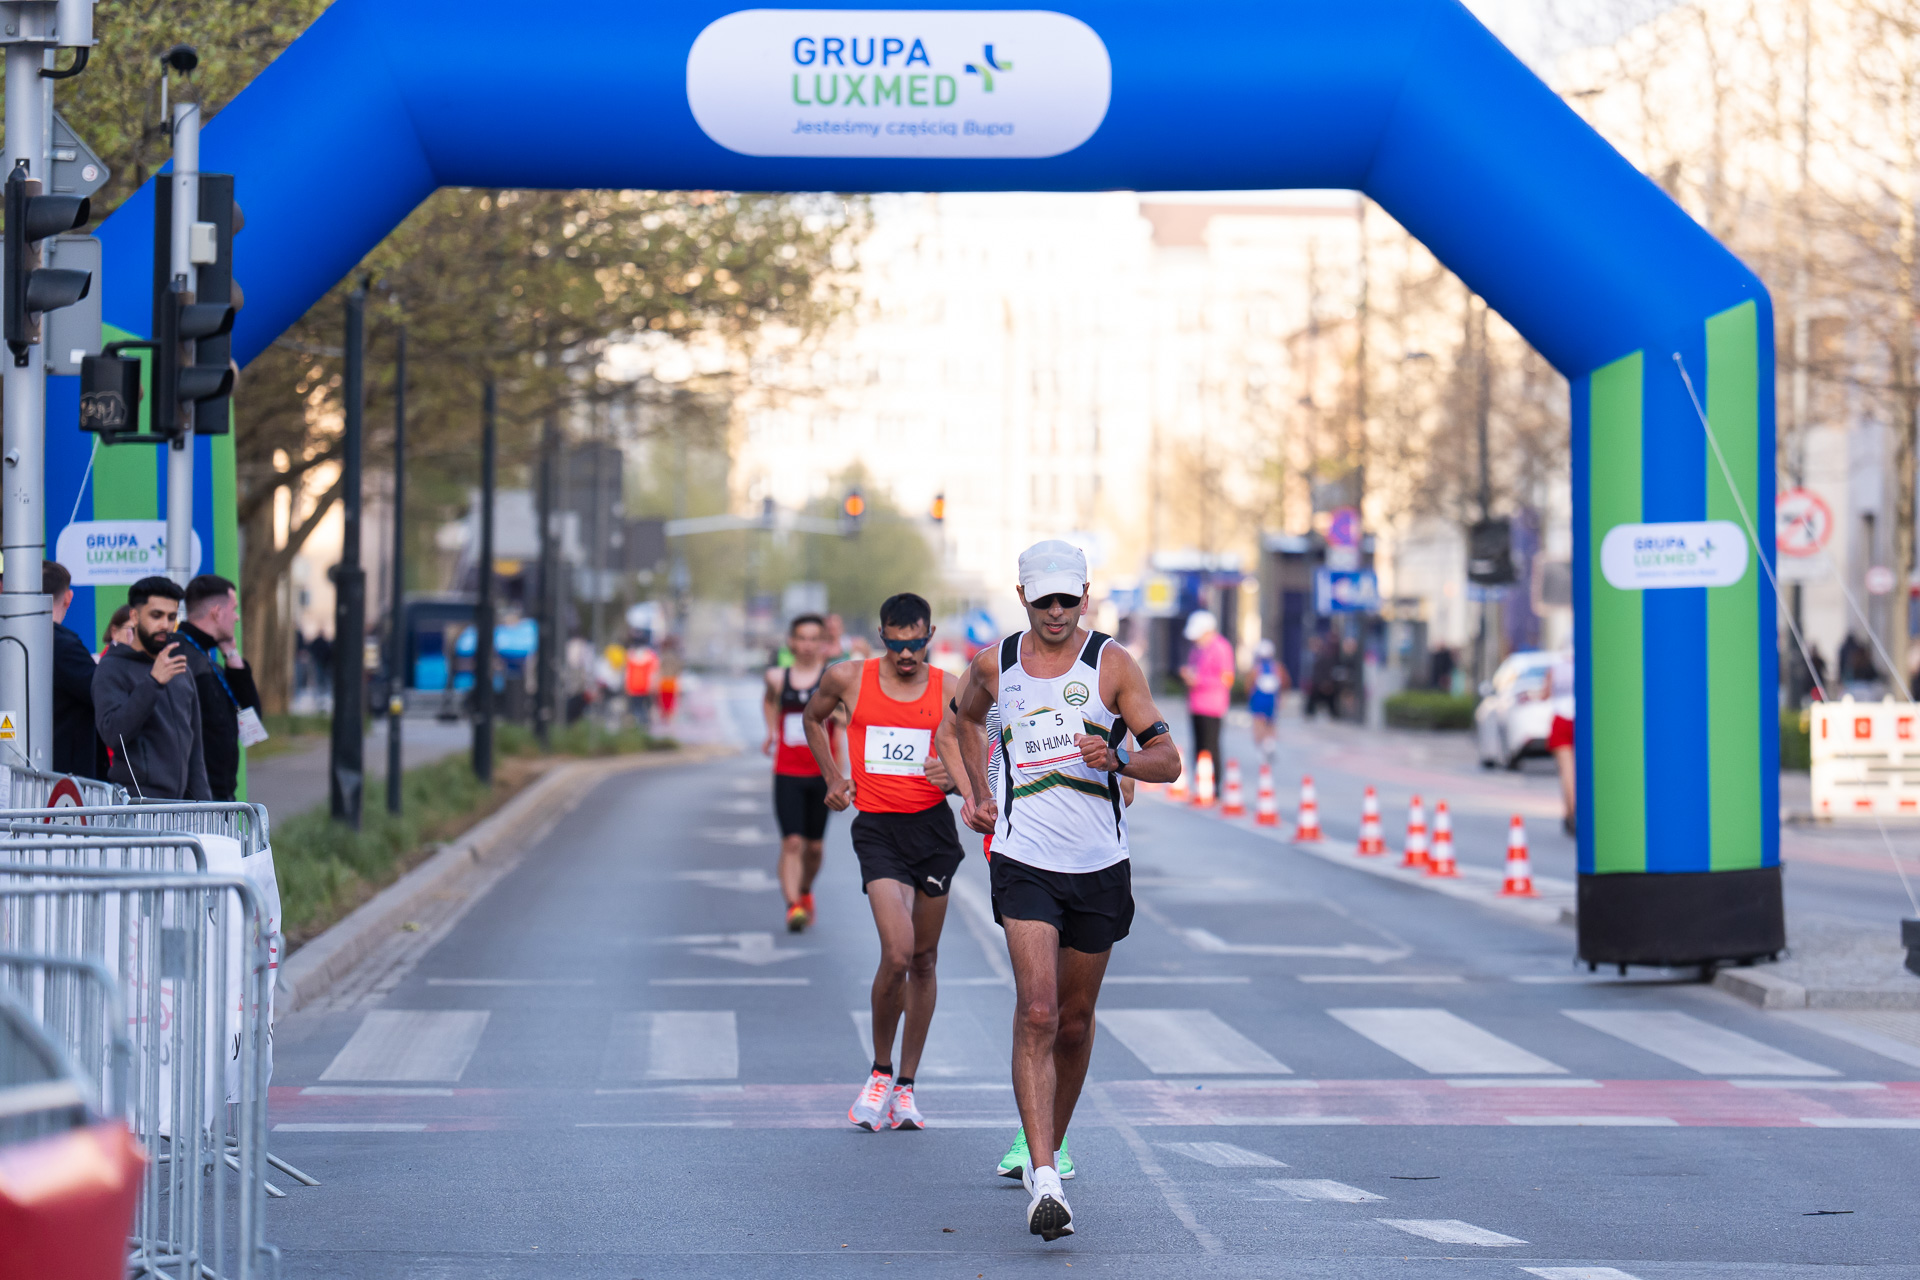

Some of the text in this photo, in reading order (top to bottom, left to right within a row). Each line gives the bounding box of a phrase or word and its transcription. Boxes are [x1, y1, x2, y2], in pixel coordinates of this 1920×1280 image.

[793, 36, 931, 67] GRUPA
[792, 73, 957, 106] LUXMED
[792, 117, 1015, 136] Jesteśmy częścią Bupa
[86, 534, 138, 548] GRUPA
[1634, 538, 1686, 551] GRUPA
[86, 549, 149, 563] LUXMED
[1634, 552, 1697, 566] LUXMED
[1067, 685, 1086, 695] RKS
[1055, 713, 1064, 726] 5
[882, 743, 915, 761] 162
[1025, 740, 1041, 754] BEN
